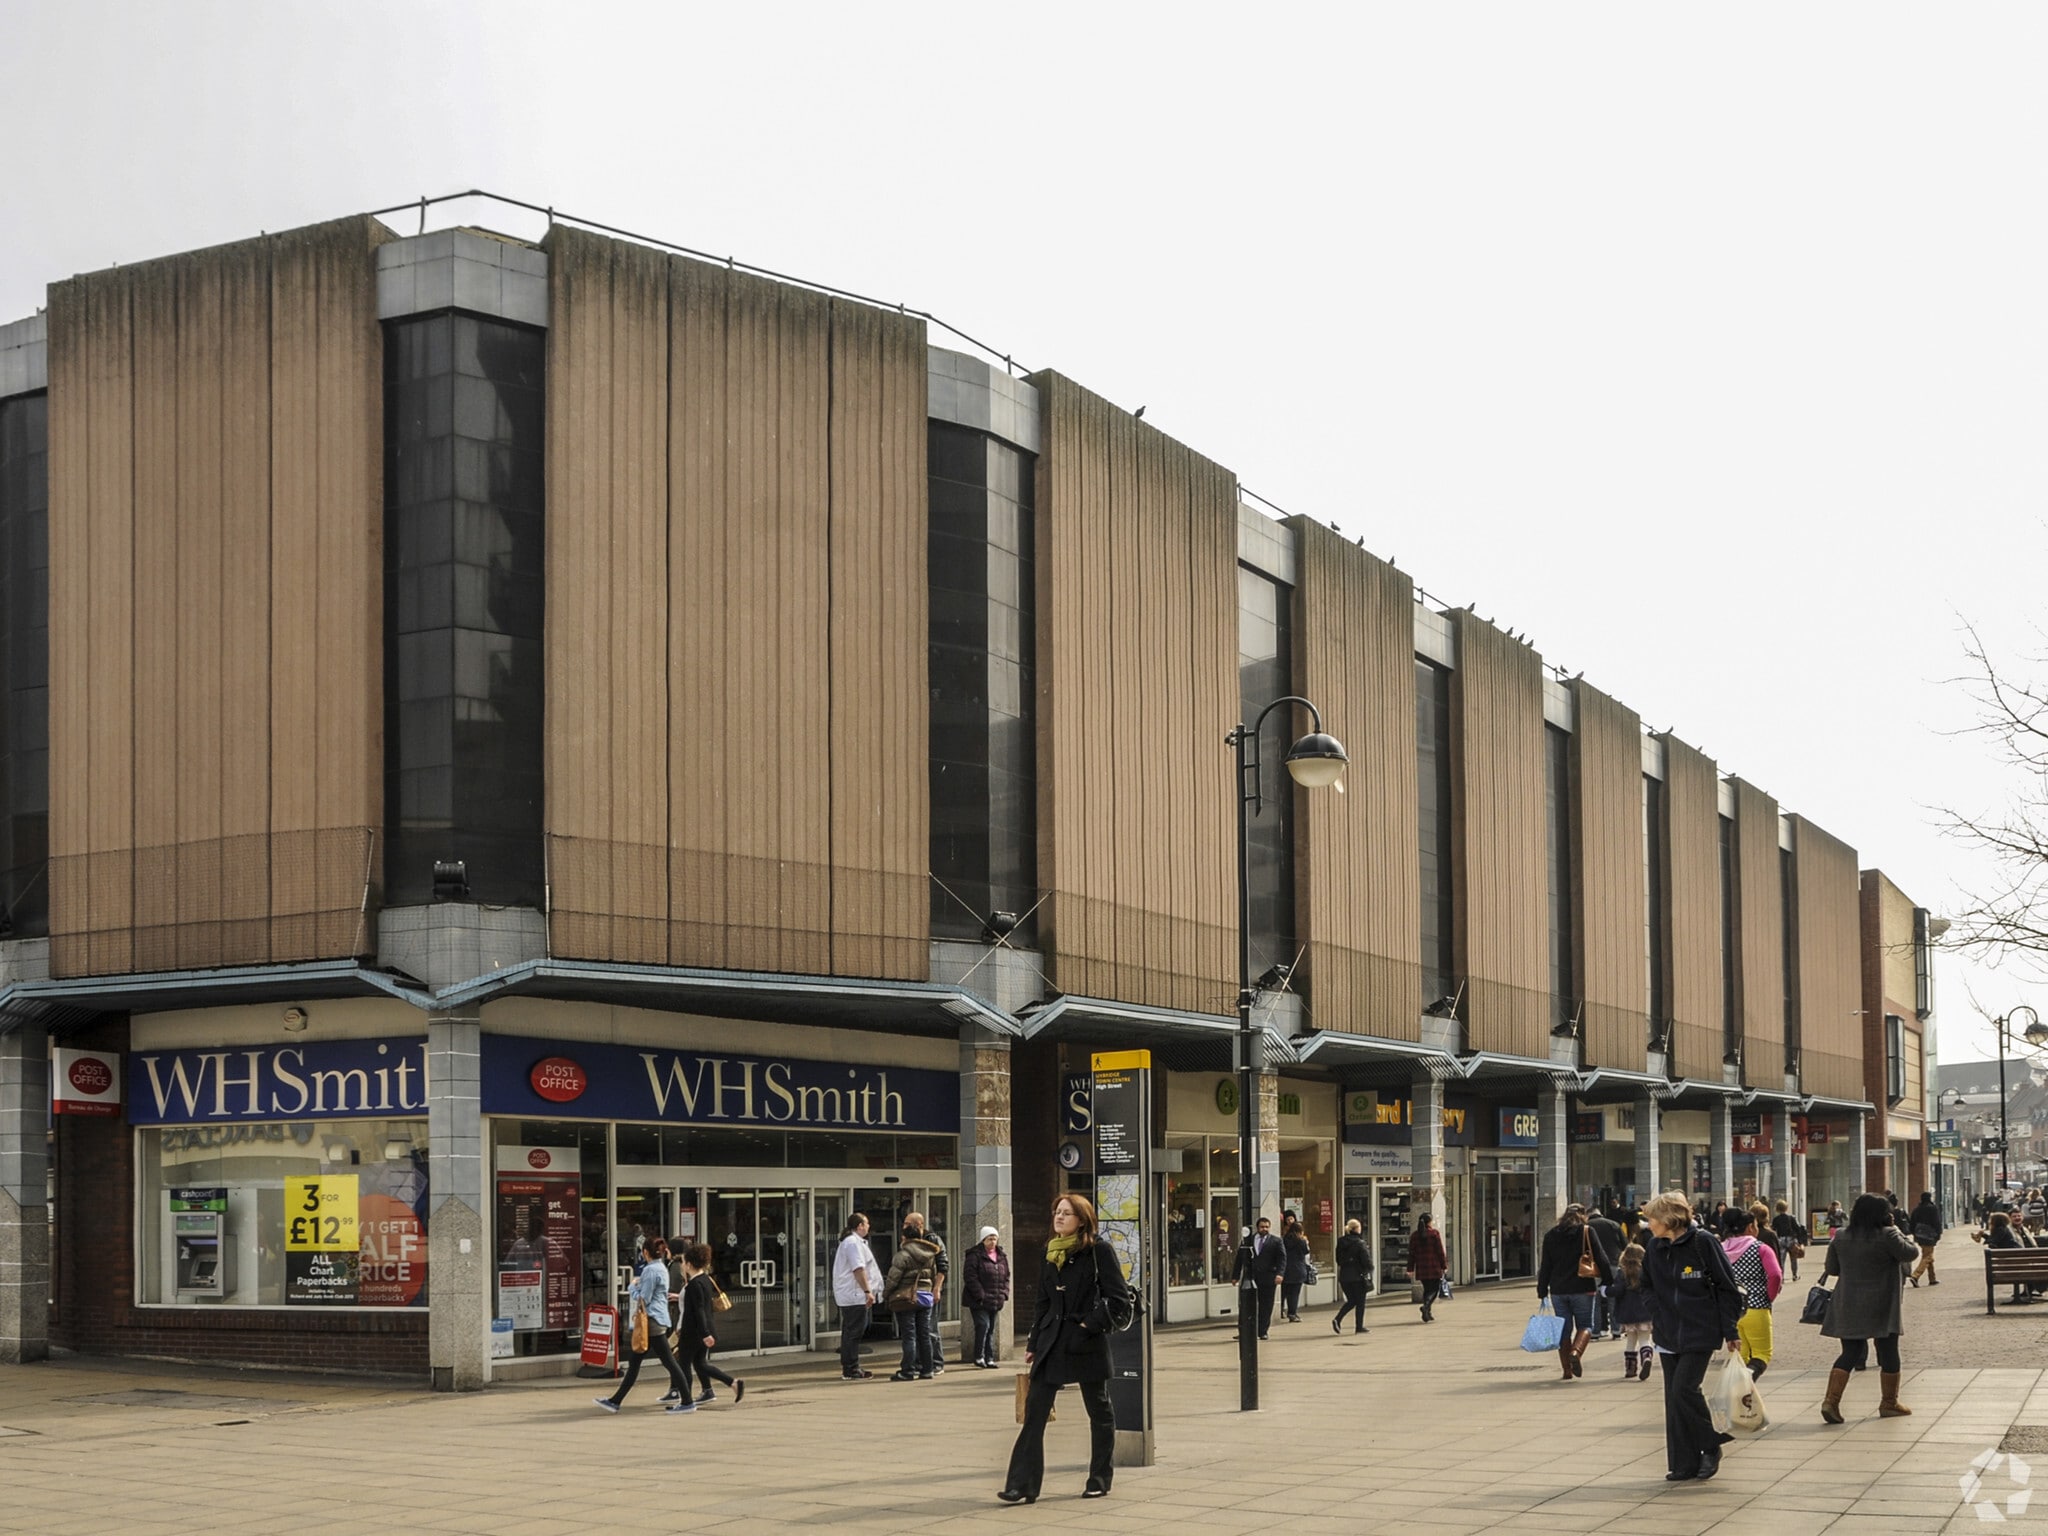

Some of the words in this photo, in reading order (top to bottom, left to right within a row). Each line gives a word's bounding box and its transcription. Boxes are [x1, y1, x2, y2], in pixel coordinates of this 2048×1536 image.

[79, 1065, 103, 1076] POST
[545, 1064, 576, 1078] POST
[73, 1074, 108, 1086] OFFICE
[539, 1077, 579, 1091] OFFICE
[639, 1052, 906, 1126] WHSmith
[1376, 1098, 1401, 1125] ard
[181, 1189, 212, 1198] cashpoint
[303, 1184, 320, 1212] 3
[321, 1194, 340, 1202] FOR
[548, 1201, 561, 1210] get
[379, 1221, 408, 1234] GET
[413, 1221, 418, 1232] 1
[359, 1235, 419, 1261] ALF
[311, 1255, 333, 1265] ALL
[309, 1266, 335, 1276] Chart
[359, 1262, 411, 1282] RICE
[296, 1277, 348, 1287] Paperbacks
[365, 1284, 402, 1293] hundreds
